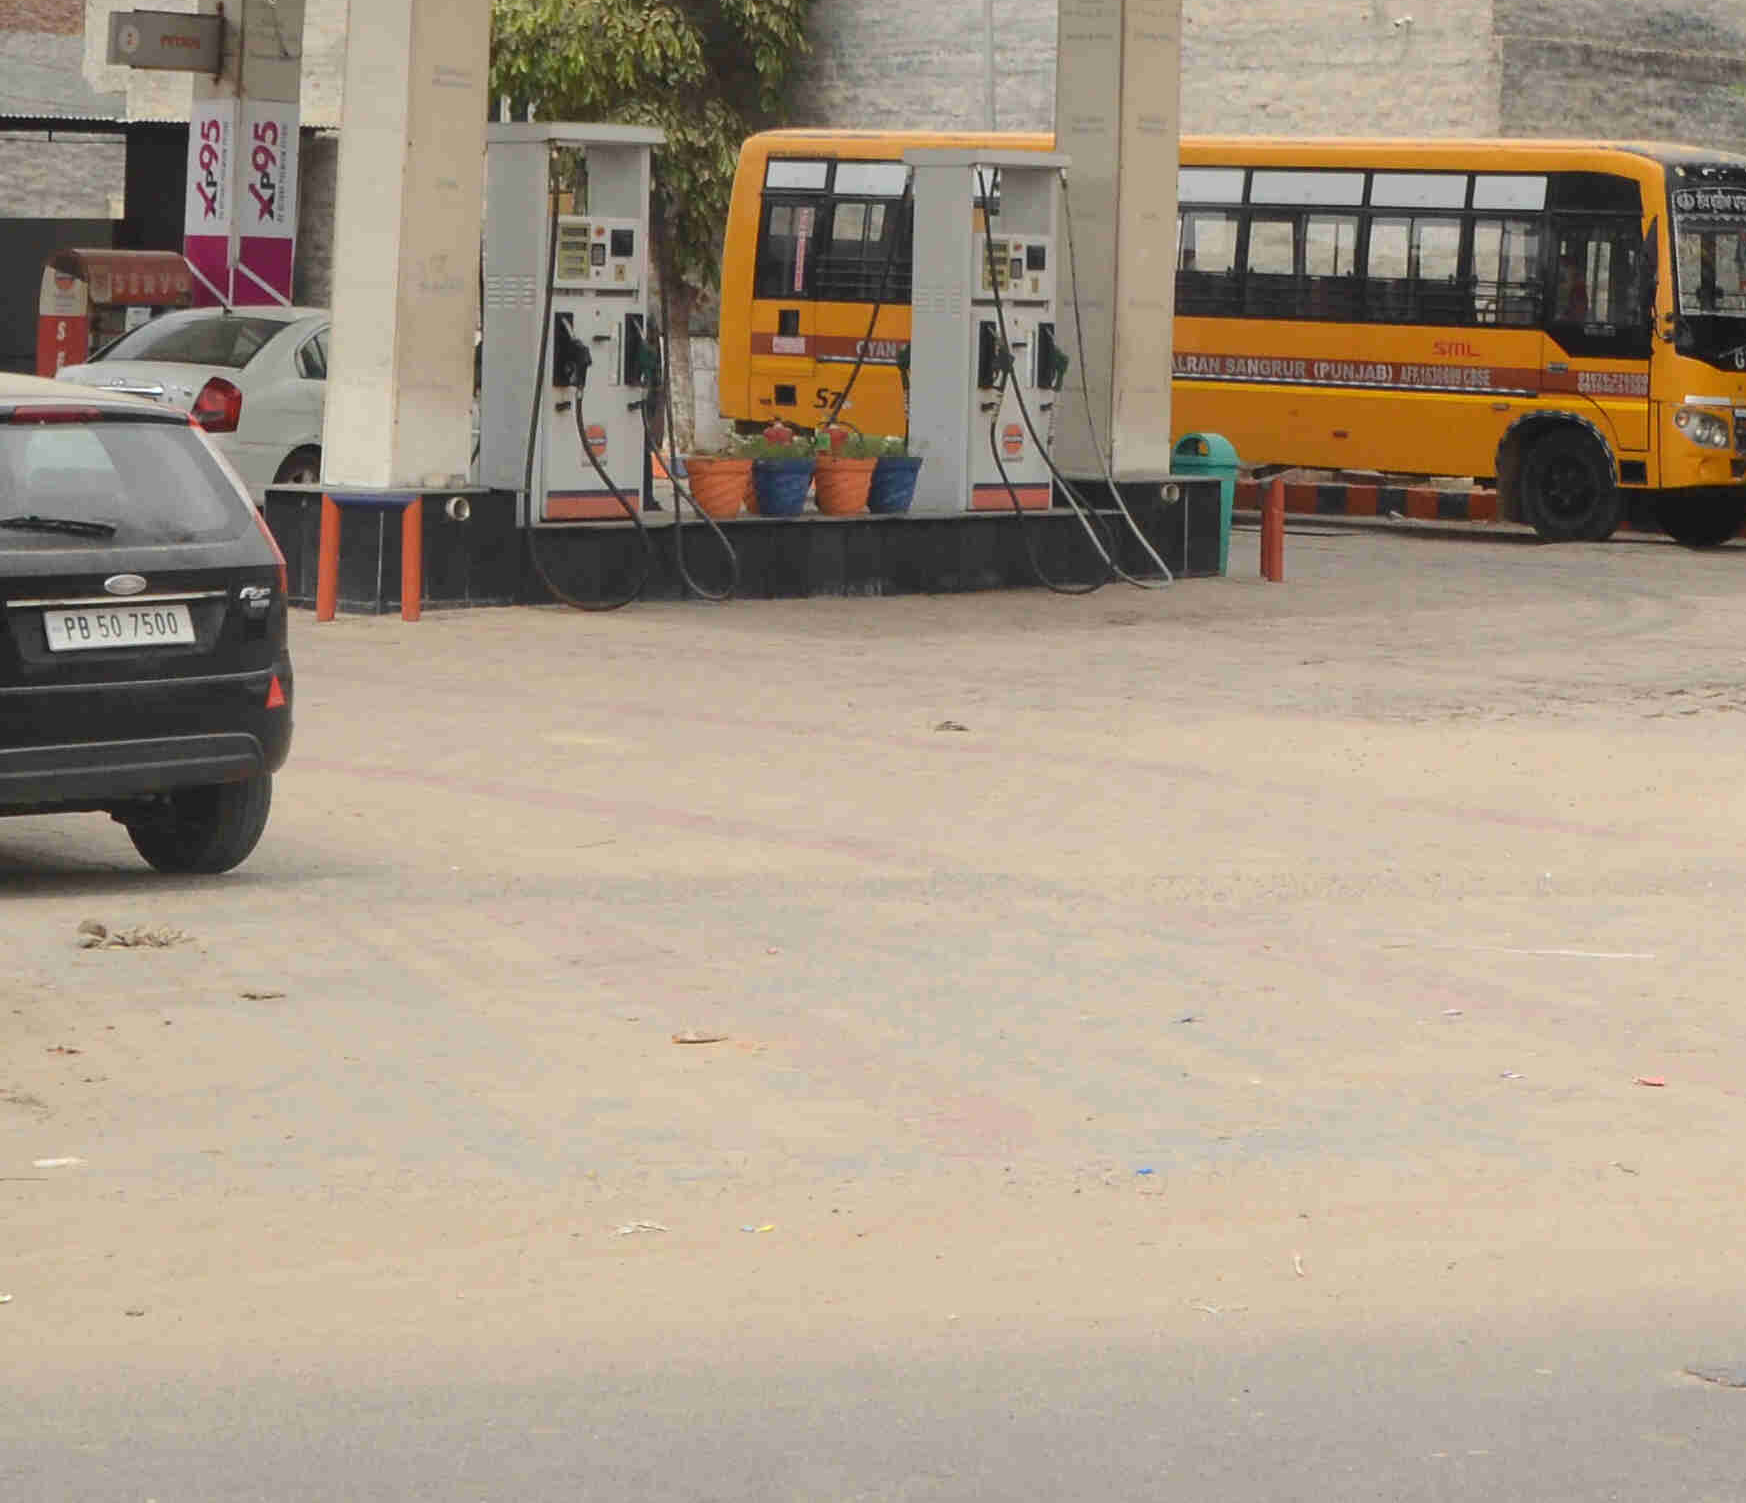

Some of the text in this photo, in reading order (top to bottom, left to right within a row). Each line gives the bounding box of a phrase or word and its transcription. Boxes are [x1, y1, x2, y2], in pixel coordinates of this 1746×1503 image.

[196, 119, 222, 222] XP95
[249, 121, 279, 222] XP95
[1172, 355, 1220, 373] ALRAN
[1313, 363, 1392, 383] (PUNJAB)
[64, 612, 177, 641] PB 50 7500
